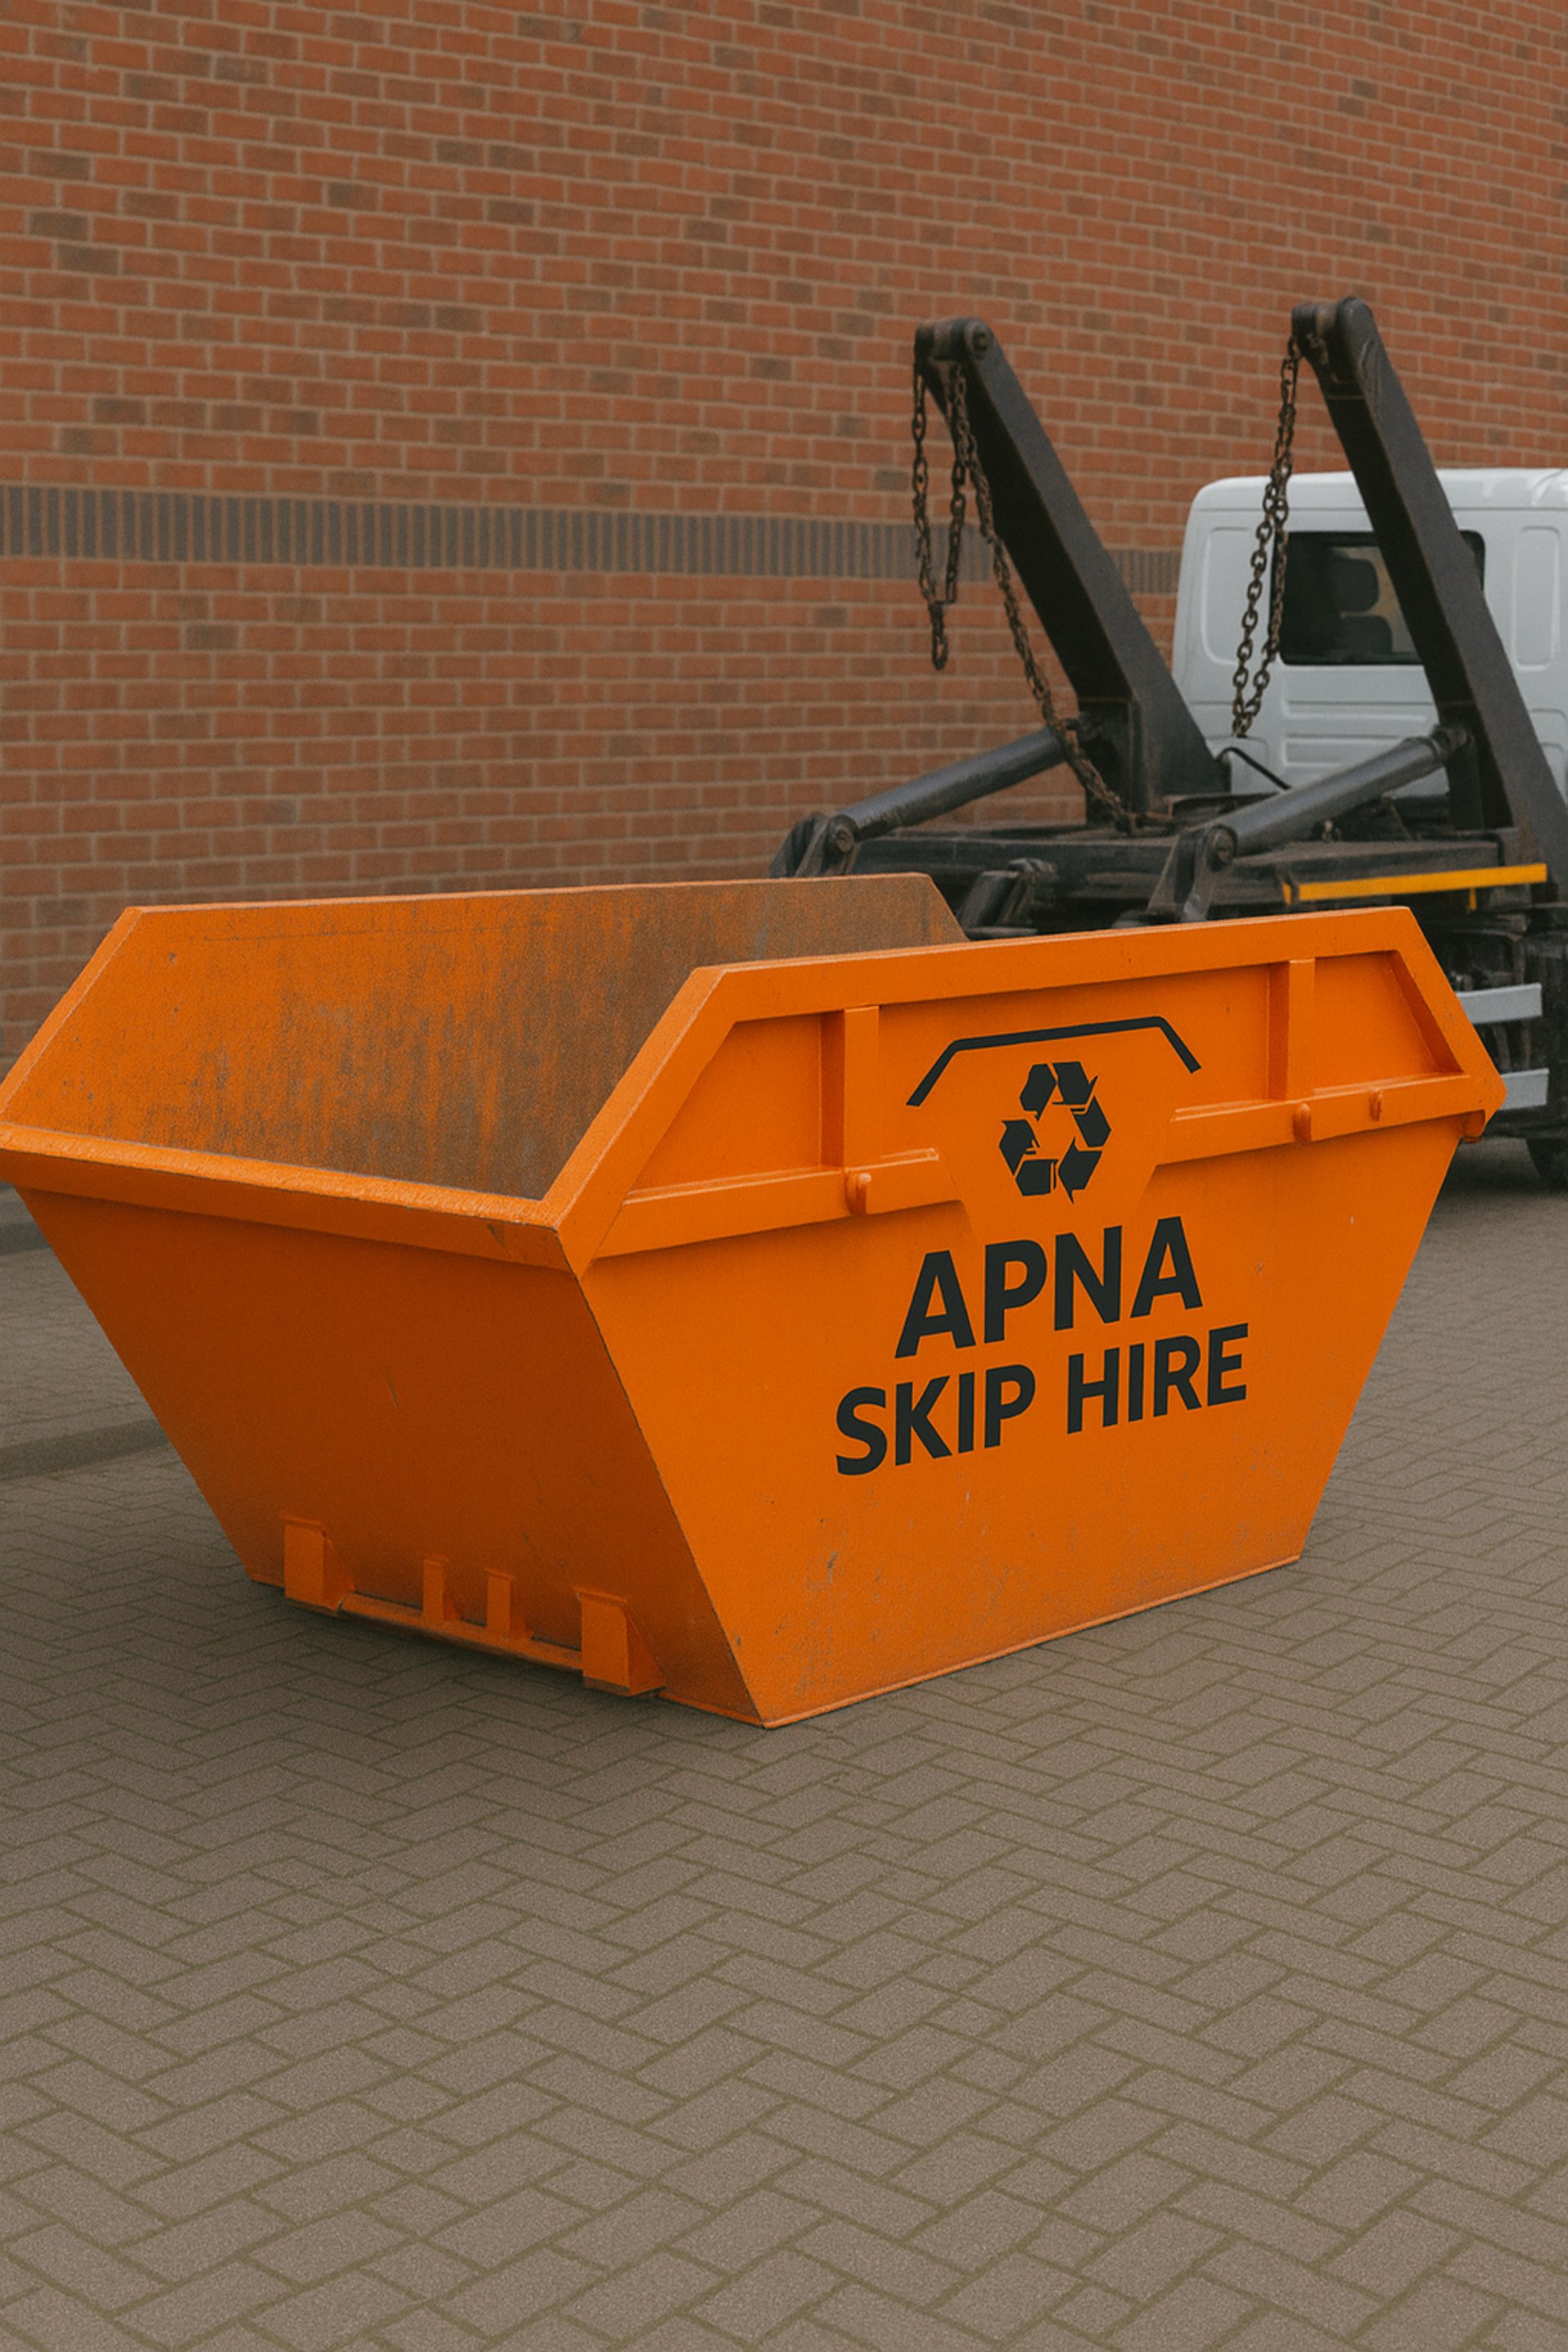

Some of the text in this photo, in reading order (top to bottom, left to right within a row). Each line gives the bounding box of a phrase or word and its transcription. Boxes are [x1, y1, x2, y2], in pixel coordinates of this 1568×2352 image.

[895, 1216, 1203, 1359] APNA
[836, 1323, 1249, 1476] SKIP HIRE
